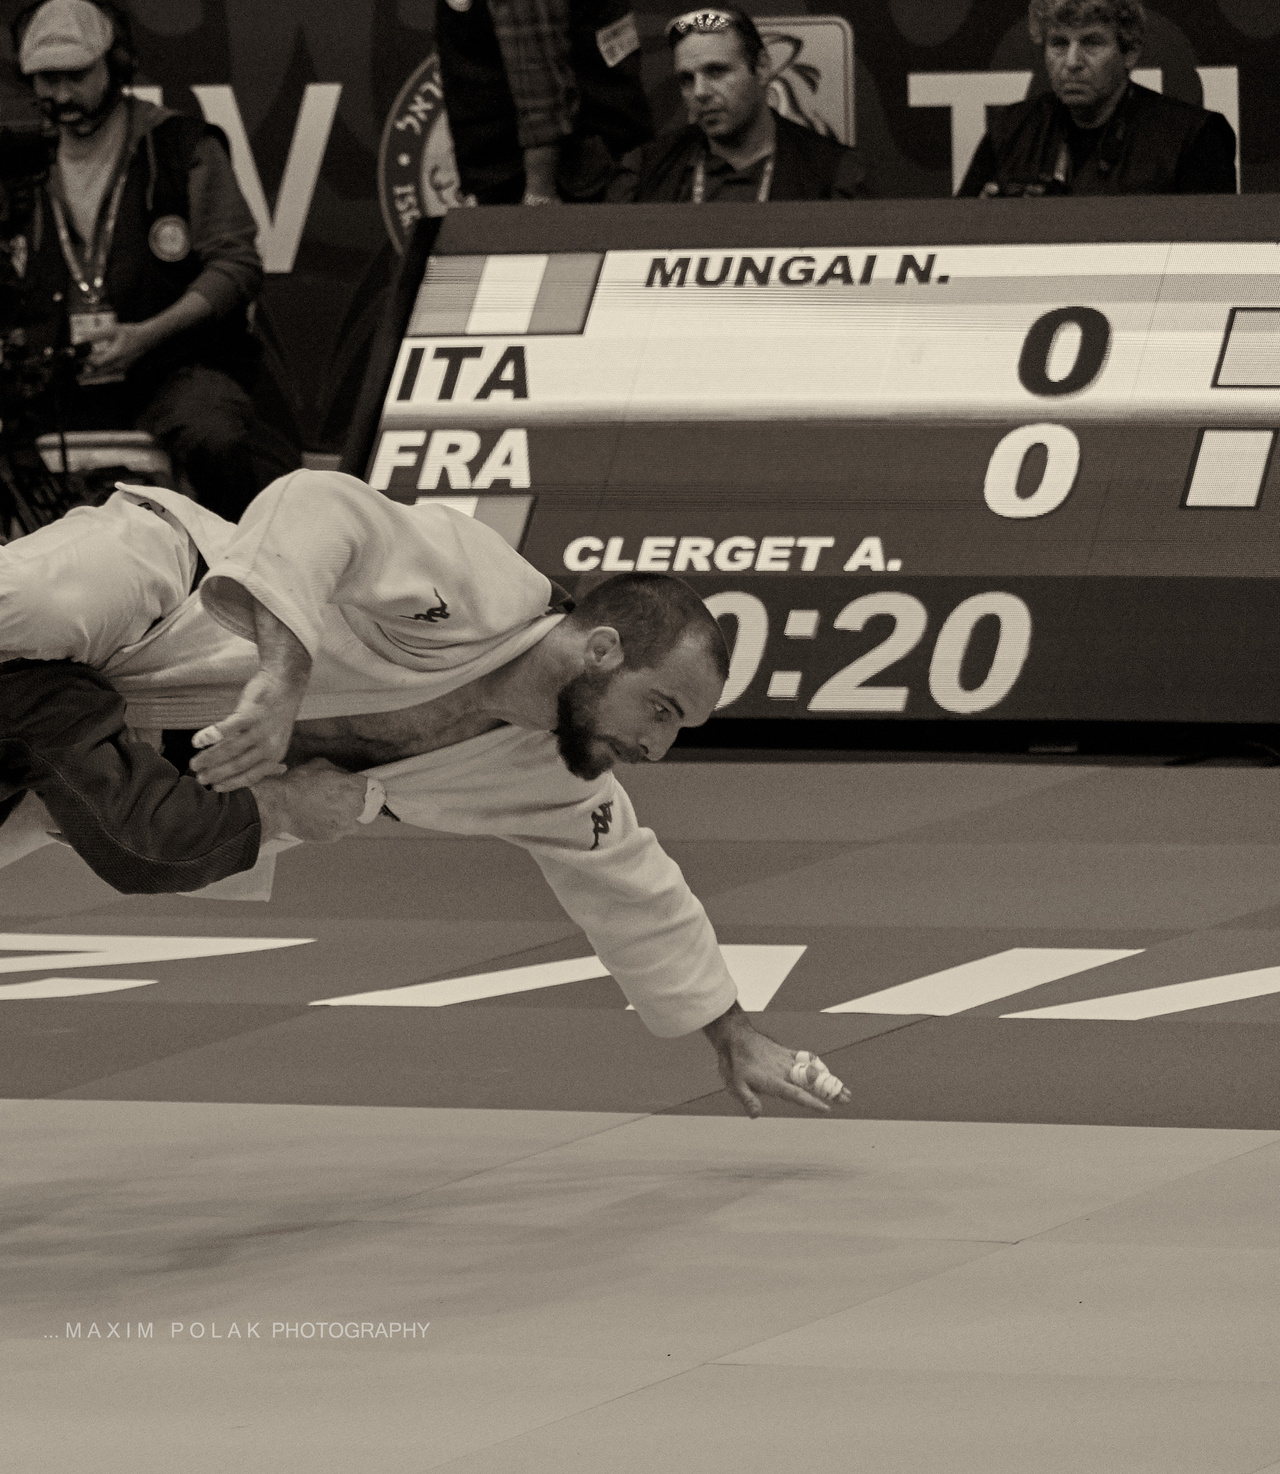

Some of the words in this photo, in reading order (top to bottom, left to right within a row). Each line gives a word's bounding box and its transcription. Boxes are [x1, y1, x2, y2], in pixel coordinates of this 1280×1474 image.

[645, 254, 877, 288] MUNGAI
[894, 253, 952, 285] N.
[395, 344, 530, 403] ITA
[1017, 304, 1113, 399] 0
[367, 428, 531, 490] FRA
[983, 422, 1081, 519] 0
[563, 536, 836, 572] CLERGET
[844, 537, 904, 572] A.
